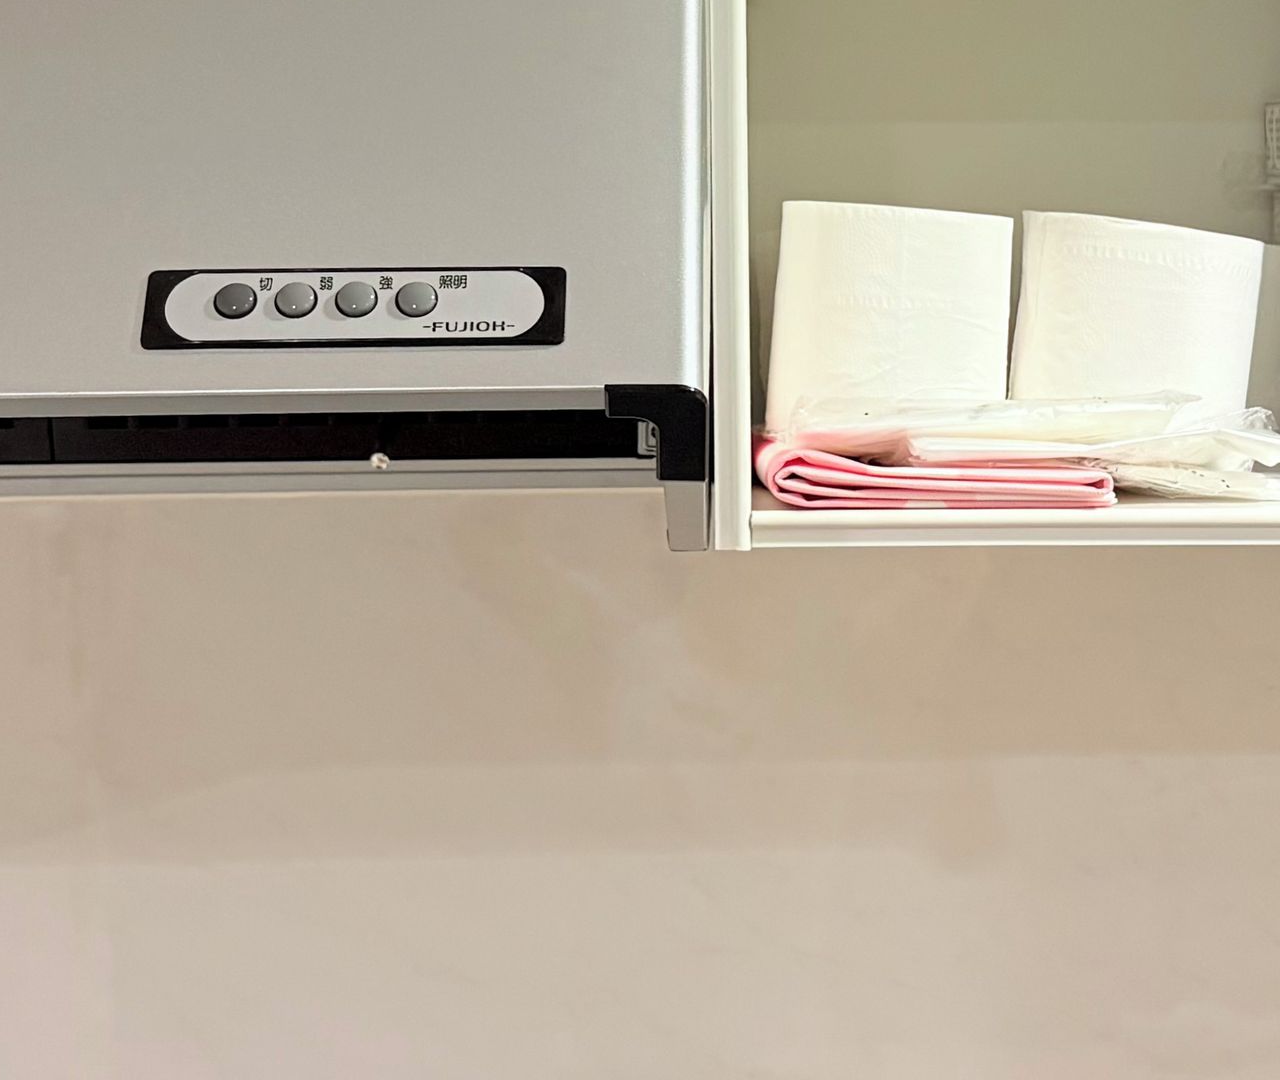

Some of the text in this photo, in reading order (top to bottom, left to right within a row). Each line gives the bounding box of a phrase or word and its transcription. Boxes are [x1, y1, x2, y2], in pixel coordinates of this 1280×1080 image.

[258, 277, 273, 290] 切
[319, 277, 334, 290] 弱
[379, 276, 394, 290] 強
[439, 275, 467, 289] 照明
